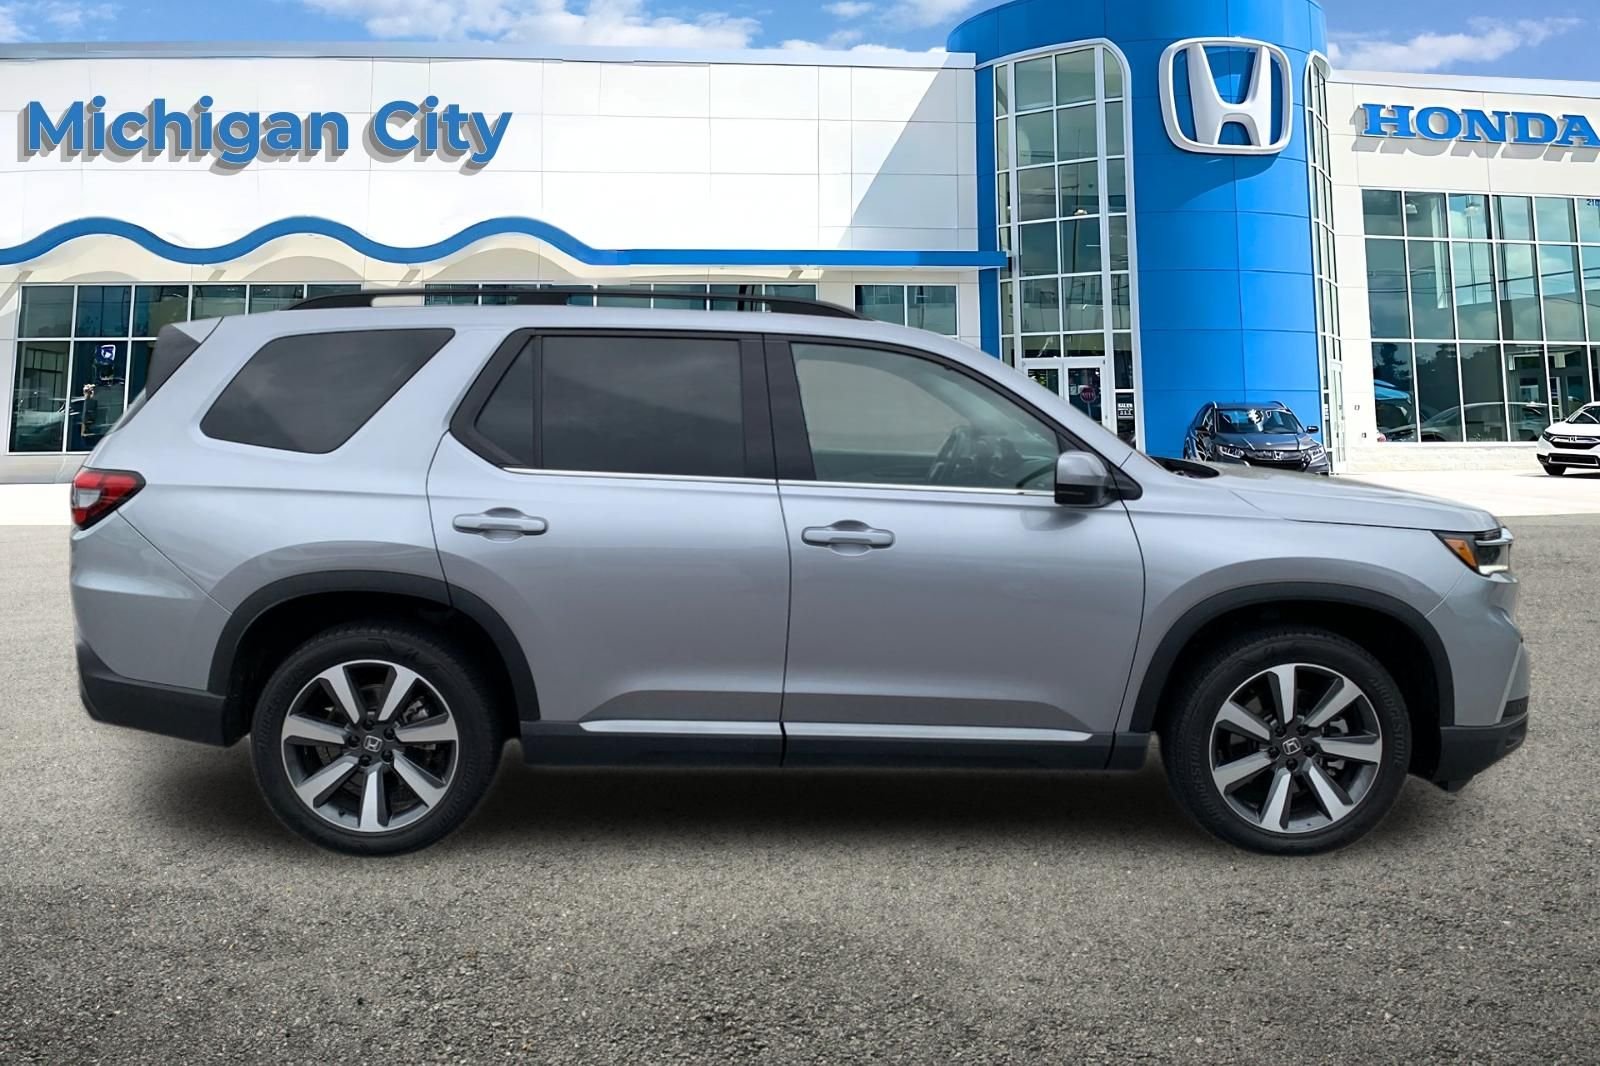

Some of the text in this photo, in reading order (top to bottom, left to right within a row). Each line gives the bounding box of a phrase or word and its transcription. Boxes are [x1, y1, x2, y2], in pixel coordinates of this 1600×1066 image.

[28, 95, 514, 164] Michigan City
[1362, 103, 1600, 147] HONDA
